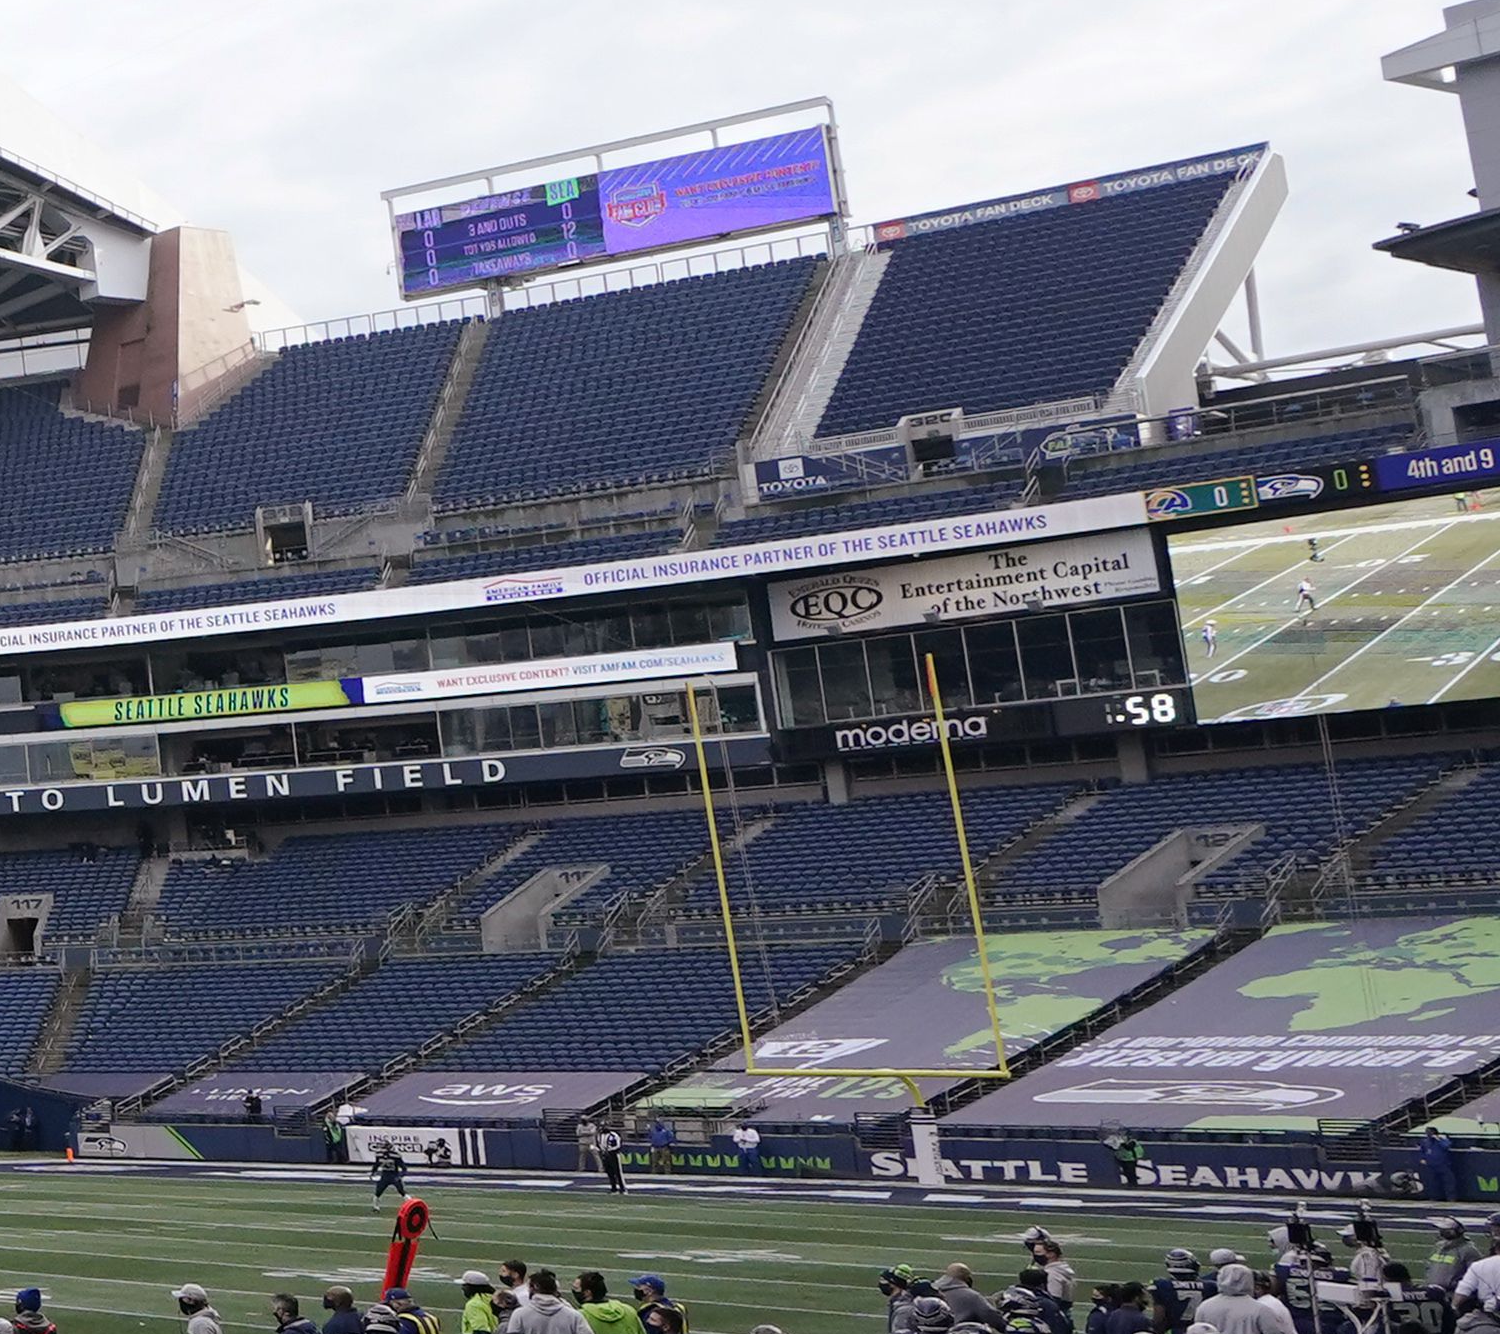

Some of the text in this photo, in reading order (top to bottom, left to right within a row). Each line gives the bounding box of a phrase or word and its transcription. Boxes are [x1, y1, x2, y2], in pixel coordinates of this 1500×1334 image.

[1103, 170, 1172, 193] TOYOTA
[1176, 161, 1210, 178] FAN
[907, 193, 1054, 233] TOYOTA FAN DECK
[757, 475, 828, 493] TOYOTA
[1215, 448, 1493, 507] 0 0 4th and 9
[583, 514, 1048, 587] OFFICIAL INSURANCE PARTNER OF THE SEATTLE SEAHAWKS
[988, 551, 1028, 570] The
[900, 553, 1130, 600] Entertainment Capital
[802, 590, 875, 618] EQC
[956, 597, 986, 612] the
[993, 580, 1104, 608] Northwest
[113, 687, 289, 721] SEATTLE SEAHAWKS
[5, 788, 65, 813] TO
[106, 772, 292, 807] LUMEN
[335, 759, 506, 792] FIELD
[10, 898, 40, 911] 117
[445, 1082, 553, 1097] aws
